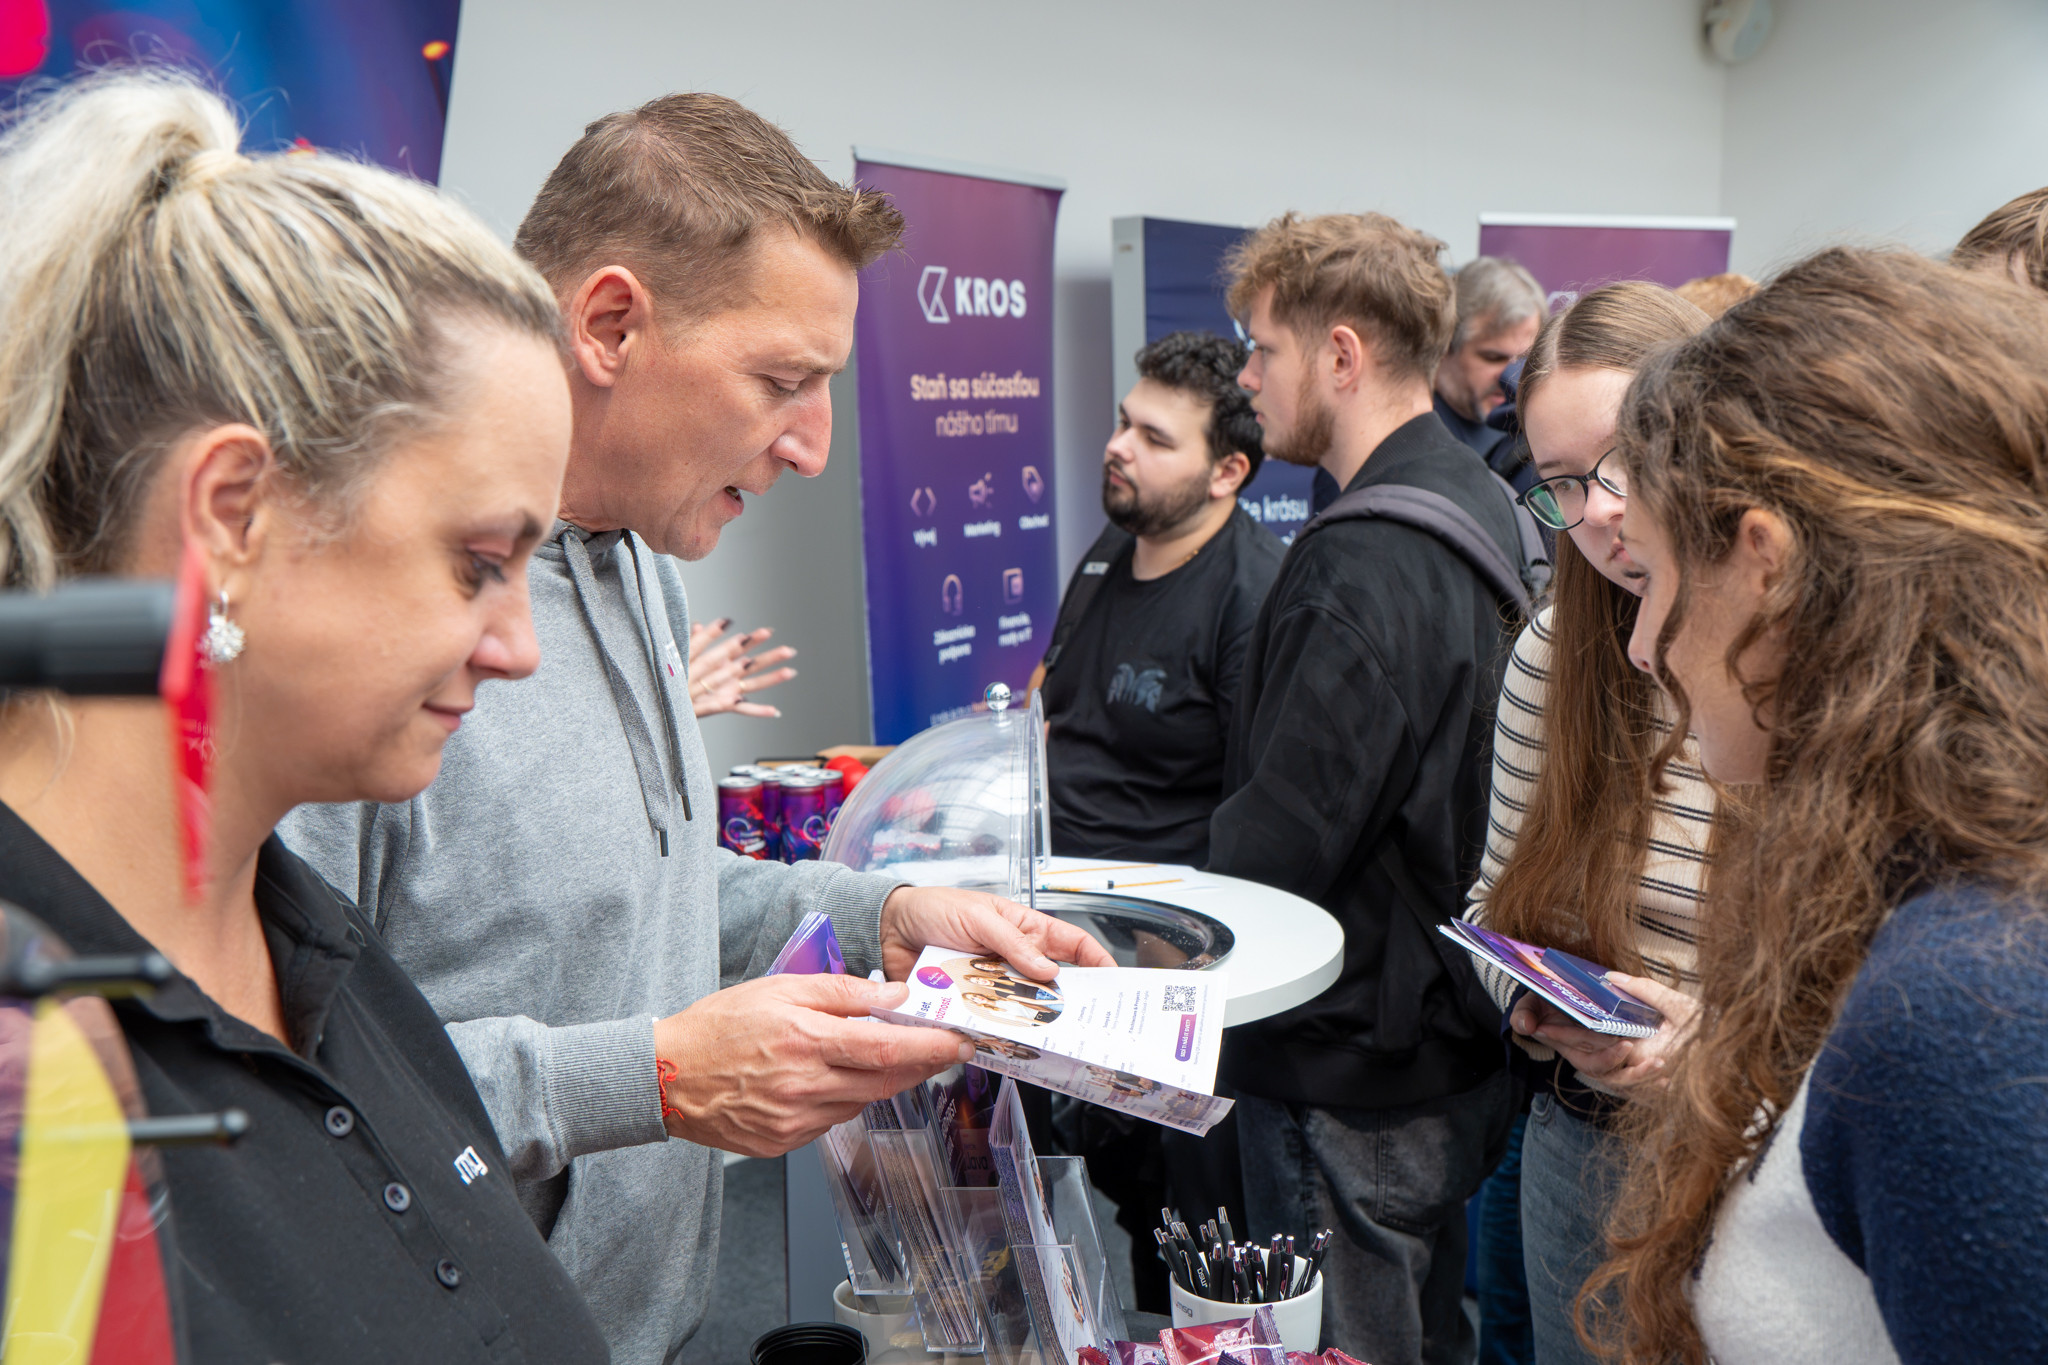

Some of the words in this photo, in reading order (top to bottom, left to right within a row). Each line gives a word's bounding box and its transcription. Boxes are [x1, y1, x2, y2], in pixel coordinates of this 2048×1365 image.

[954, 276, 1027, 318] KROS
[911, 373, 948, 401] Staň
[949, 377, 970, 399] sa
[971, 371, 1040, 399] súčasťou
[936, 410, 984, 437] nášho
[985, 409, 1018, 434] tímu
[1263, 493, 1309, 522] krásu
